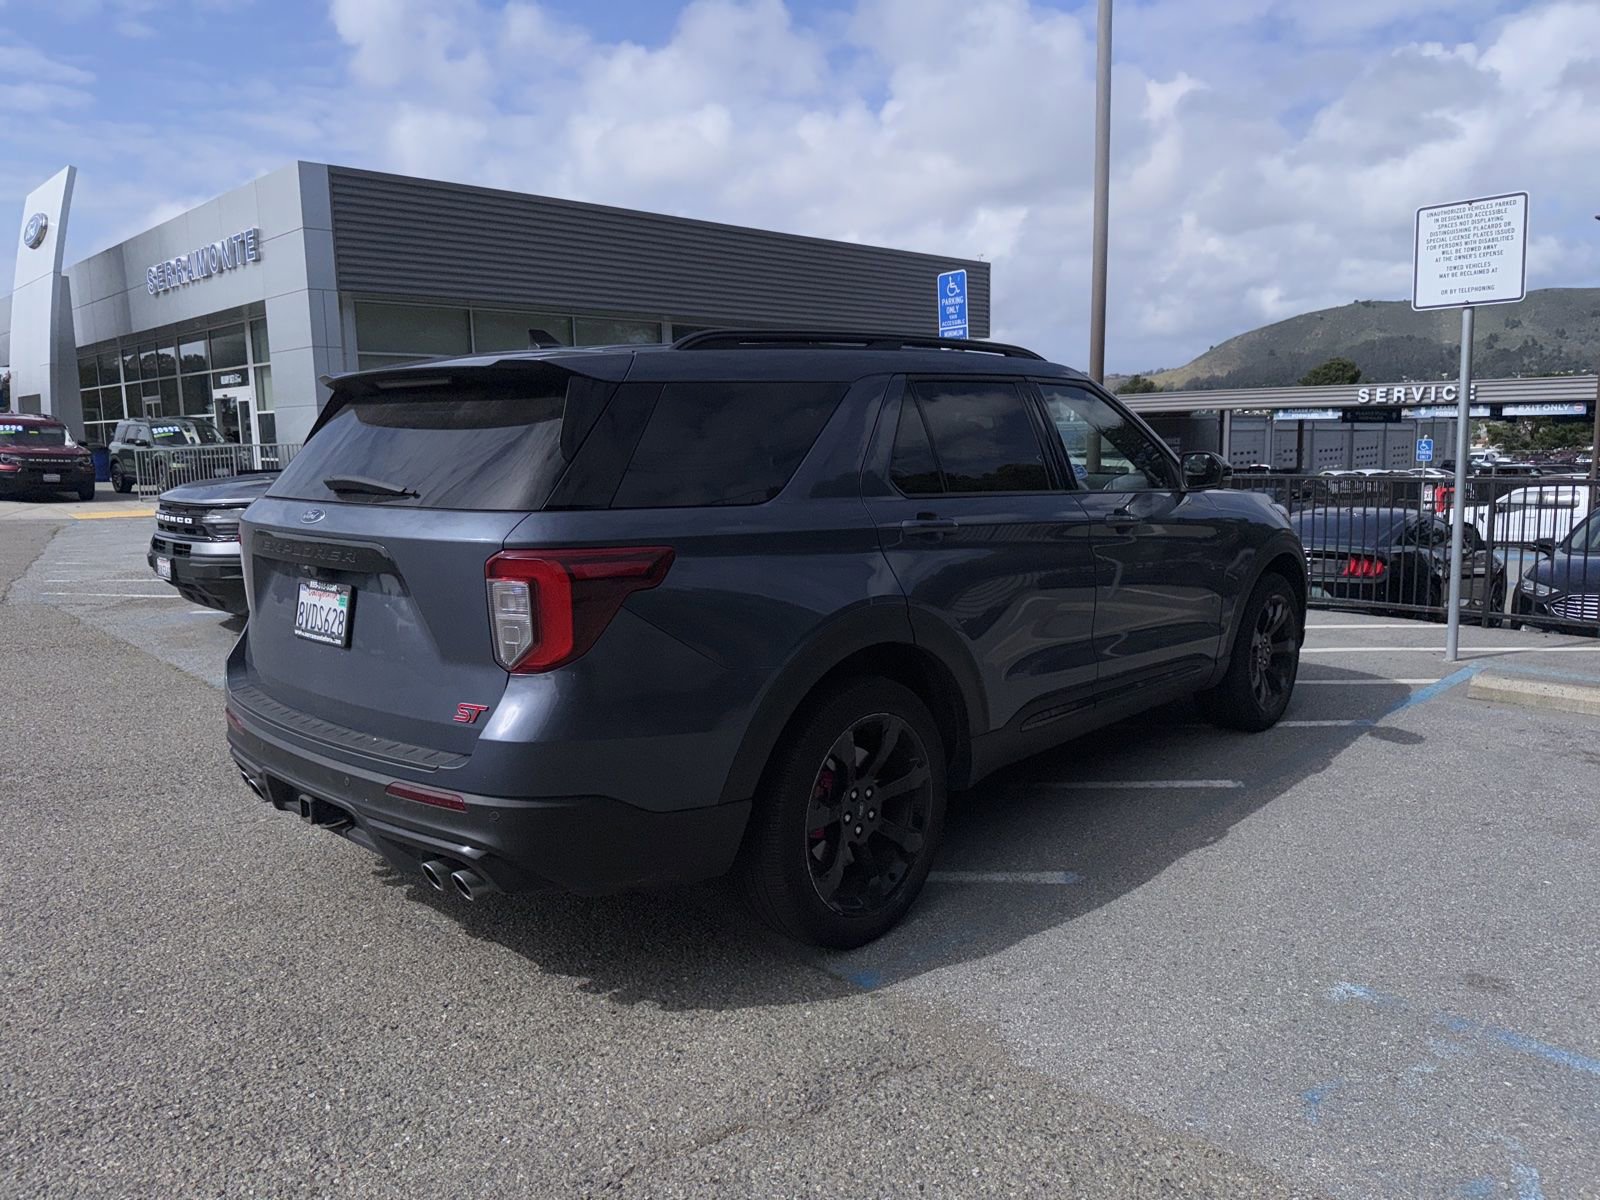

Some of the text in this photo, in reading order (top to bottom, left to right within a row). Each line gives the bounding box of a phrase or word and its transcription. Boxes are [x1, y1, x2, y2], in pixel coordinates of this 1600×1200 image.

[1427, 199, 1517, 218] UNAUTHORIZED VEHICLES PARKED
[1441, 213, 1473, 223] DESIGNATED
[1475, 208, 1508, 217] ACCESSIBLE
[1430, 227, 1472, 237] DISTINGUISHING
[1473, 223, 1502, 232] PLACARDS
[1438, 222, 1457, 230] SPACES
[1471, 216, 1504, 225] DISPLAYING
[1426, 228, 1515, 245] SPECIAL LICENSE PLATES ISSUED
[1438, 241, 1463, 250] PERSONS
[1478, 235, 1514, 245] DISABILITIES
[147, 229, 259, 295] SERRAMONTE
[1454, 253, 1477, 261] OWNER'S
[1479, 250, 1503, 258] EXPENSE
[1460, 268, 1489, 277] RECLAIMED
[1465, 262, 1491, 270] VEHICLES
[1458, 285, 1495, 294] TELEPHONING
[942, 296, 964, 306] PARKING
[946, 305, 959, 315] ONLY
[156, 513, 192, 524] BRONCO
[263, 541, 356, 563] EXPLORER
[297, 601, 345, 636] 8VDS628
[453, 702, 489, 724] ST
